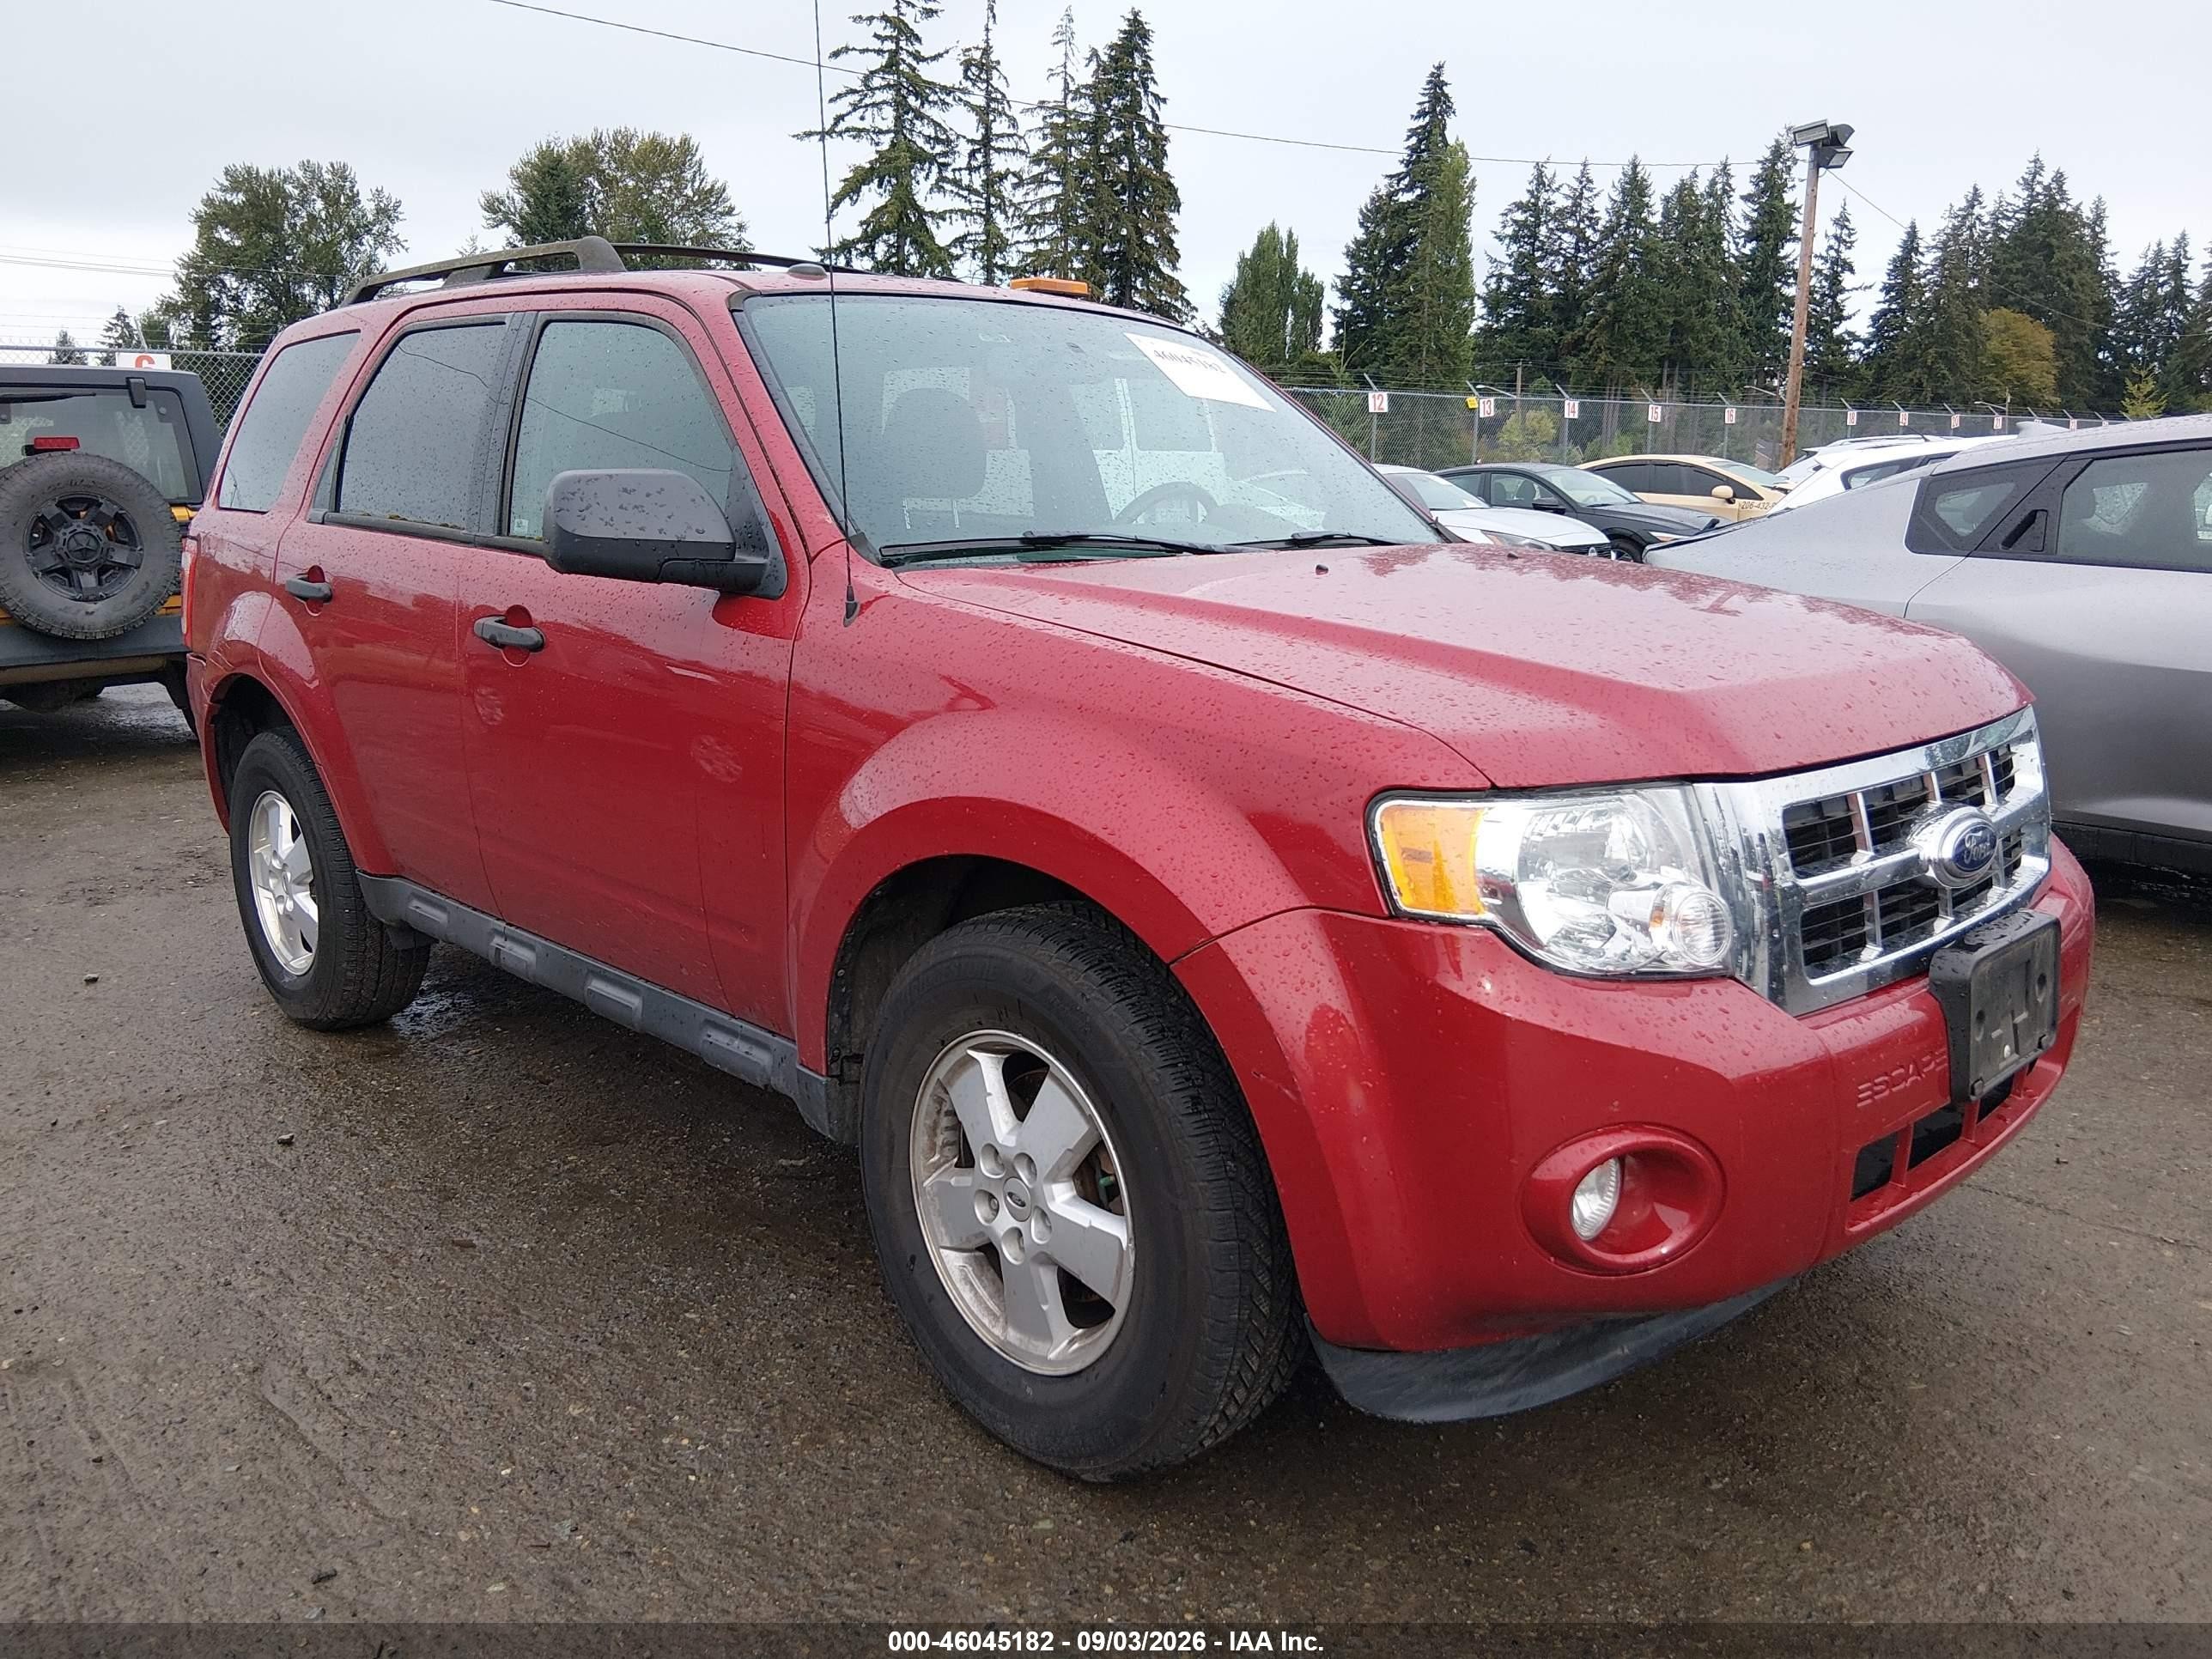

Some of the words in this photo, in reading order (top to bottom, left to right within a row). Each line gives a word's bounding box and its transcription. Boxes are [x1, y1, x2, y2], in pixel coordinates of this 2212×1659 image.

[1371, 393, 1384, 411] 12
[1482, 399, 1492, 416] 13
[1567, 402, 1577, 416] 14
[1651, 406, 1659, 420] 15
[1727, 409, 1734, 422] 16
[1849, 411, 1856, 424] 18
[1952, 415, 1960, 428] 20
[1964, 830, 1993, 864] Ford
[1856, 1047, 1948, 1109] ESCAPE
